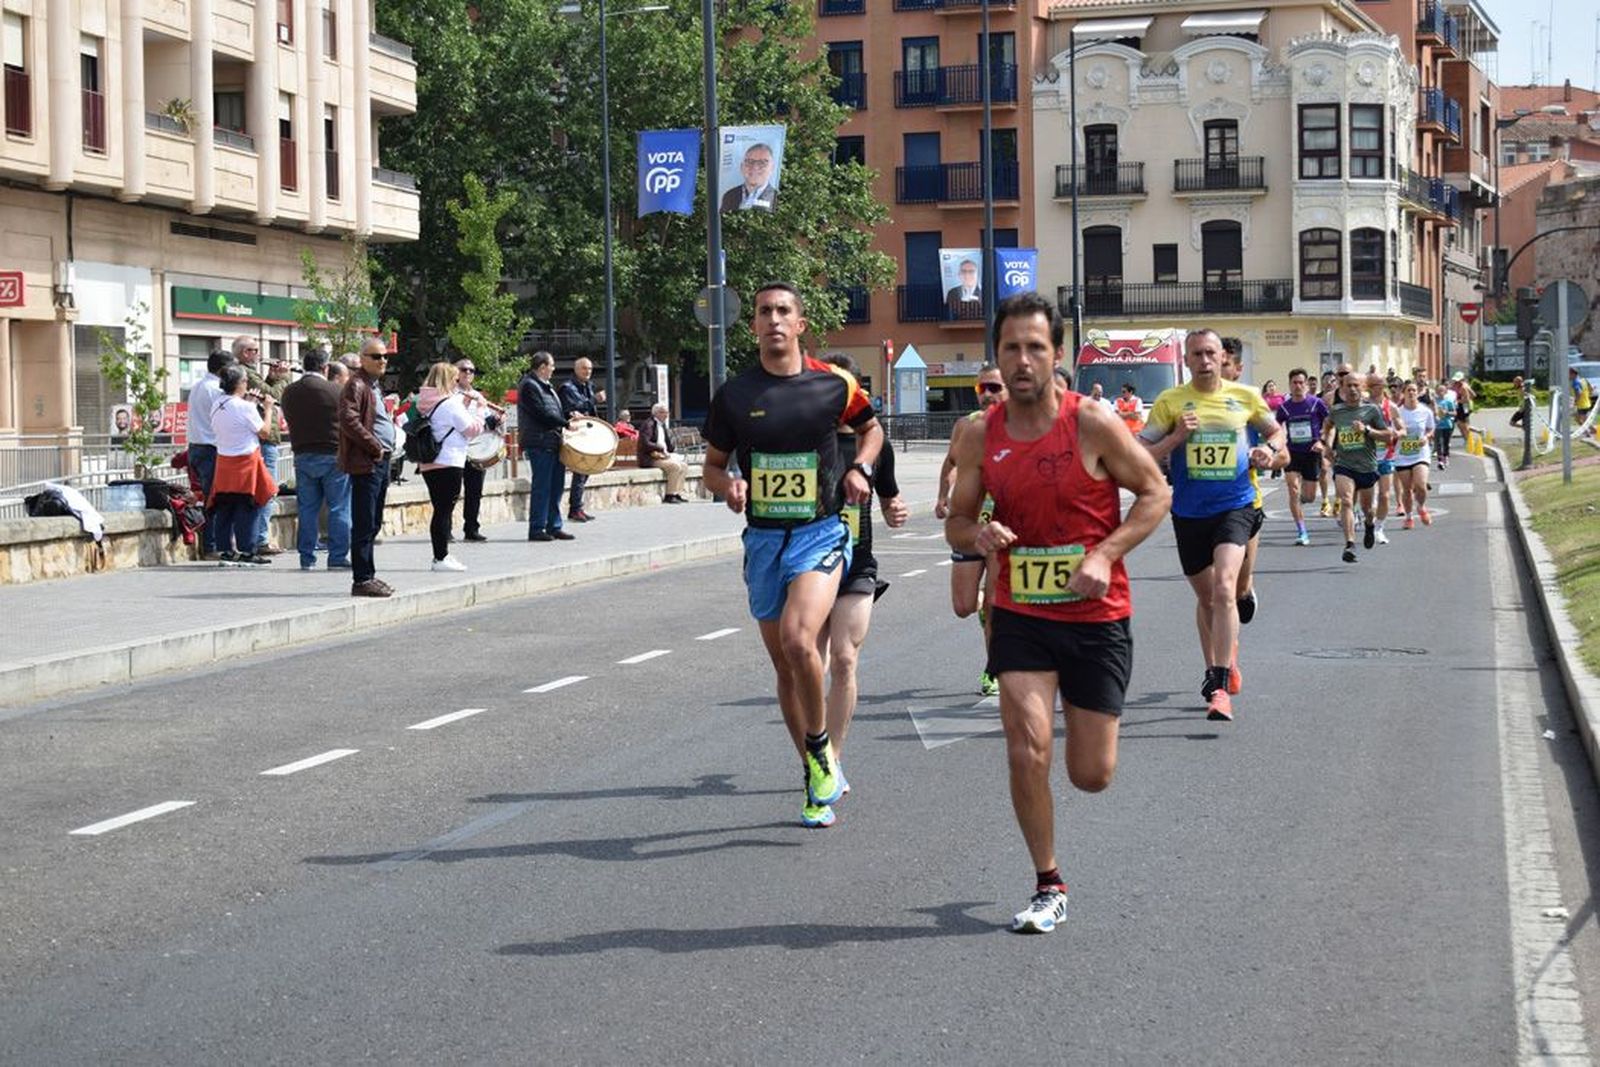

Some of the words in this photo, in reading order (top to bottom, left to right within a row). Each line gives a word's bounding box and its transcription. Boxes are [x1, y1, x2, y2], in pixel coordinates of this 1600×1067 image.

[648, 152, 685, 165] VOTA
[1004, 261, 1030, 269] VOTA
[1193, 446, 1230, 465] 137
[758, 473, 806, 498] 123
[1017, 560, 1071, 589] 175
